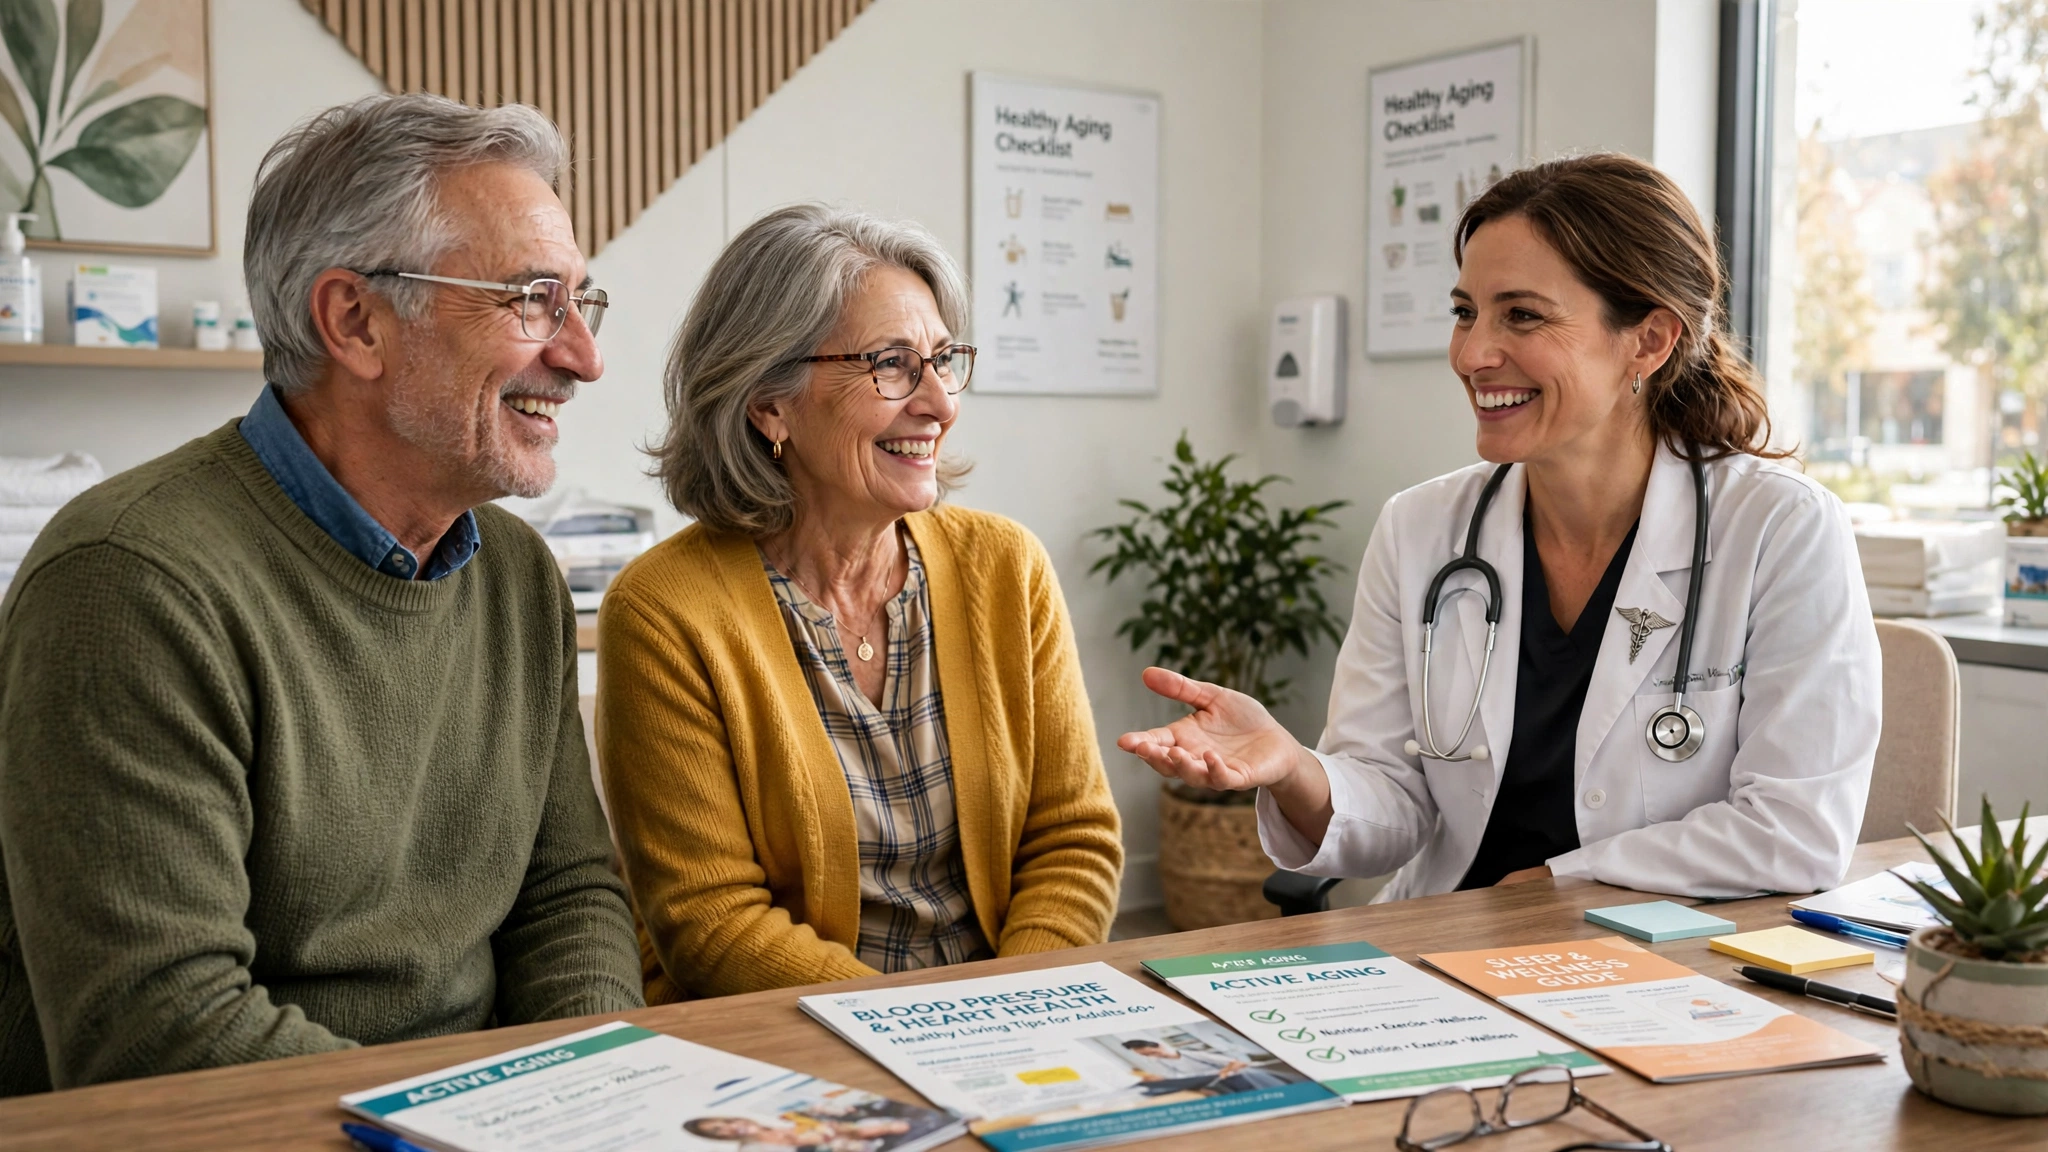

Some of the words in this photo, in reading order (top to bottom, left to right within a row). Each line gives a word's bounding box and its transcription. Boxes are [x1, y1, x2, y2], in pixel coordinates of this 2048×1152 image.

[1384, 88, 1444, 115] Healthy
[1447, 79, 1494, 107] Aging
[995, 106, 1060, 133] Healthy
[1065, 113, 1112, 142] Aging
[1384, 112, 1455, 142] Checklist
[995, 132, 1073, 159] Checklist
[1485, 953, 1563, 968] SLEEP
[1567, 951, 1592, 961] &
[1485, 958, 1629, 980] WELLNESS
[1209, 974, 1302, 991] ACTIVE
[1305, 966, 1386, 982] AGING
[1537, 971, 1625, 987] GUIDE
[851, 1001, 956, 1021] BLOOD
[960, 982, 1108, 1008] PRESSURE
[869, 1022, 895, 1033] &
[898, 1008, 997, 1030] HEART
[1002, 993, 1117, 1017] HEALTH
[890, 1030, 956, 1046] Healthy
[958, 1022, 1011, 1038] Living
[1009, 1019, 1046, 1030] Tips
[1047, 1014, 1071, 1025] for
[1075, 1008, 1126, 1021] Adults
[1127, 1004, 1155, 1015] 60+
[406, 1070, 500, 1105] ACTIVE
[500, 1049, 576, 1078] AGING
